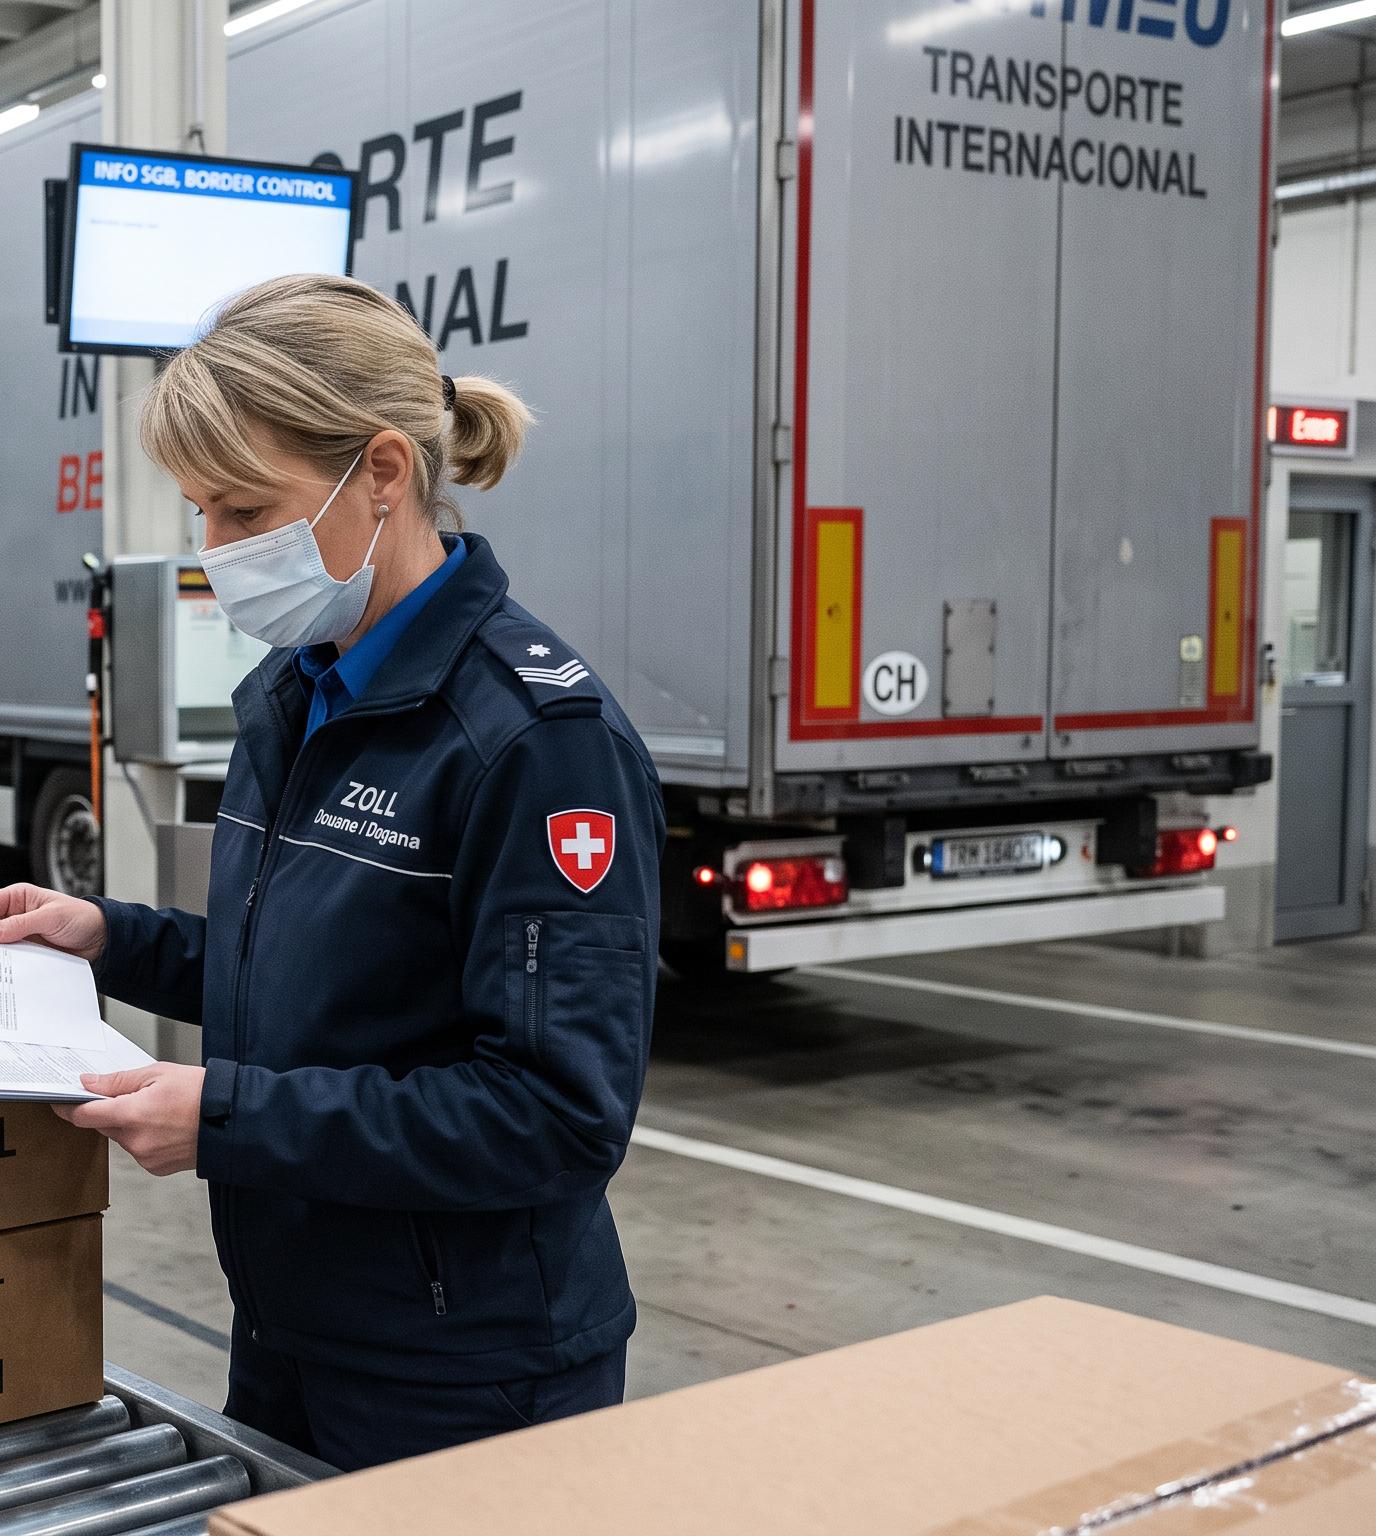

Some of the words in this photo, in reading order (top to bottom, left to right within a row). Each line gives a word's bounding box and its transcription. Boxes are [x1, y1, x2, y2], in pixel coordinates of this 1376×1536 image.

[924, 47, 1183, 127] TRANSPORTE
[894, 116, 1208, 200] INTERNACIONAL
[94, 161, 138, 183] INFO
[184, 169, 254, 194] BORDER
[256, 174, 336, 201] CONTROL
[874, 665, 915, 701] CH
[340, 781, 398, 817] ZOLL
[314, 808, 358, 833] Douane
[365, 821, 421, 850] Dogana
